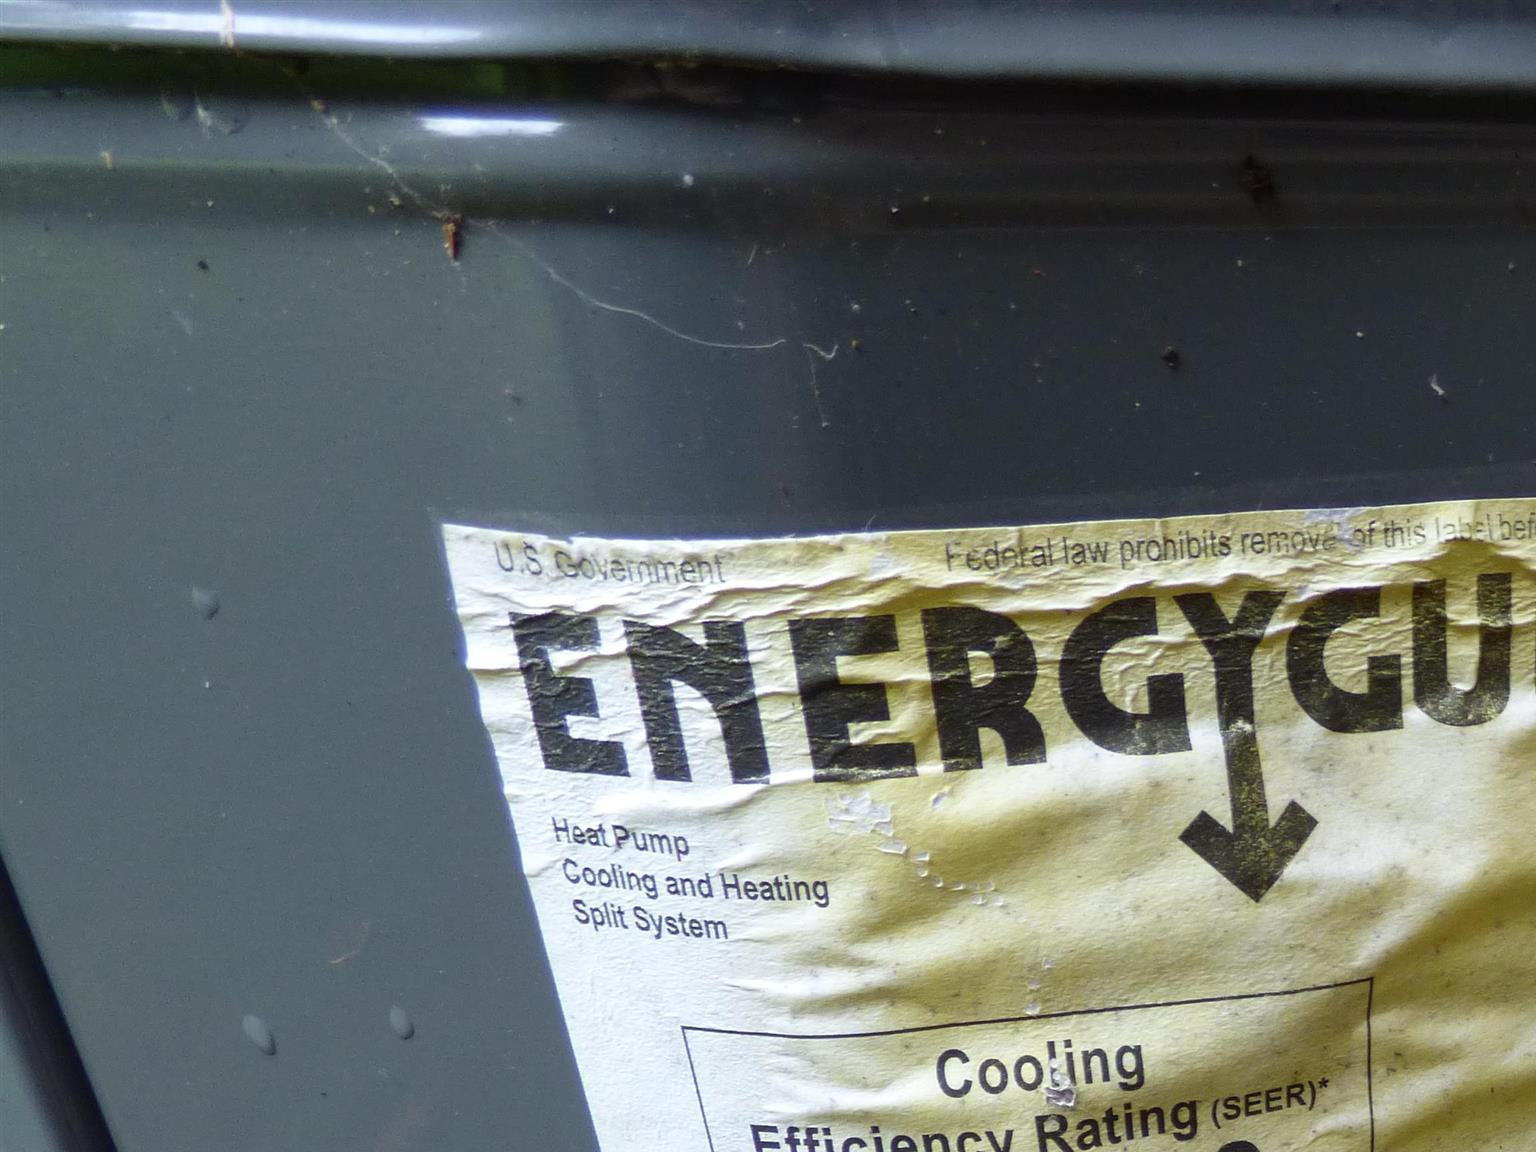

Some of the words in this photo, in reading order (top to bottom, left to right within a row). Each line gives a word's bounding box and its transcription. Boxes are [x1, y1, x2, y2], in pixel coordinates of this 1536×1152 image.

[554, 550, 726, 583] Government
[945, 536, 1053, 572] Federal
[1062, 536, 1109, 565] law
[1119, 529, 1231, 569] prohibits
[1351, 521, 1376, 551] of
[1385, 519, 1426, 548] this
[551, 817, 609, 847] Heat
[613, 825, 691, 857] Pump
[563, 858, 657, 900] Cooling
[666, 866, 714, 901] and
[720, 873, 830, 908] Heating
[573, 899, 629, 935] Split
[633, 907, 729, 941] System
[936, 1038, 1145, 1100] Cooling
